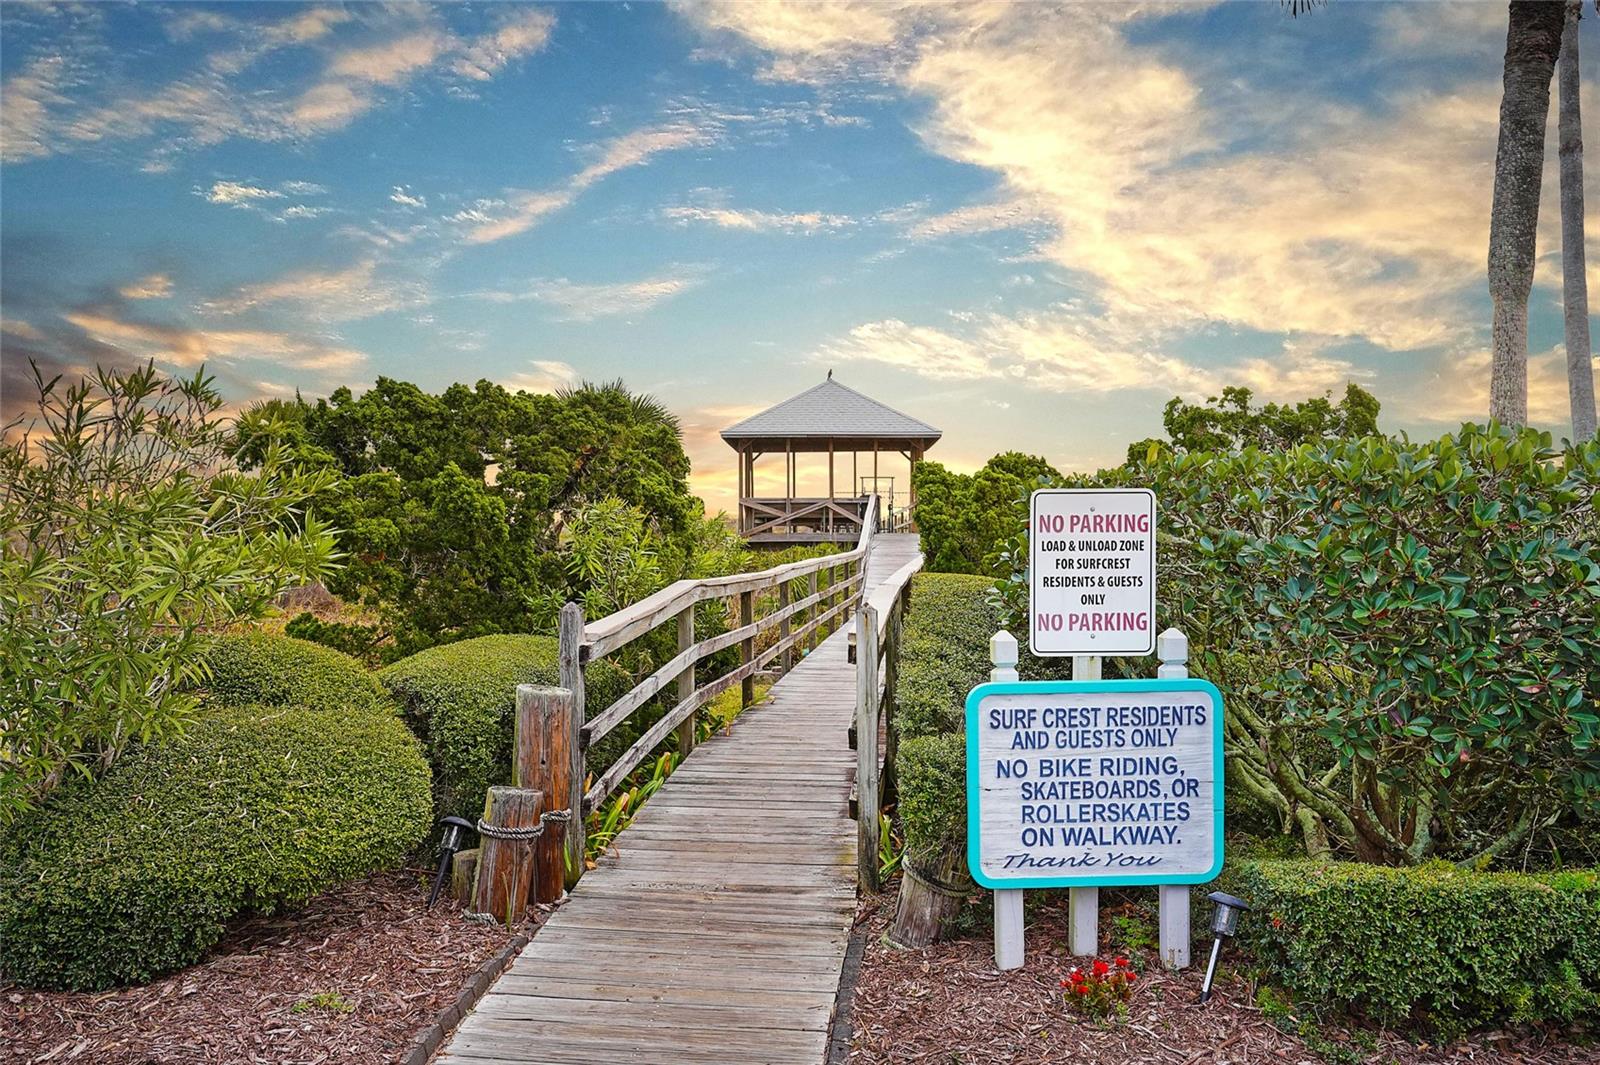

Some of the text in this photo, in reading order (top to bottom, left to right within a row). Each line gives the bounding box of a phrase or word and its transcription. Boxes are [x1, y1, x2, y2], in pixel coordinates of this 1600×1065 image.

[1040, 514, 1148, 533] NO PARKING
[1042, 540, 1144, 551] LOAD & UNLOAD ZONE
[1056, 559, 1130, 569] FOR SURFCREST
[1043, 576, 1143, 587] RESIDENTS & GUESTS
[1081, 594, 1105, 605] ONLY
[1038, 613, 1147, 631] NO PARKING
[990, 706, 1205, 729] SURF CREST RESIDENTS
[1012, 728, 1177, 750] AND GUESTS ONLY
[997, 757, 1185, 778] NO BIKE RIDING,
[1172, 779, 1199, 797] OR
[1022, 803, 1190, 823] ROLLERSKATES
[1022, 826, 1181, 846] ON WALKWAY.
[1003, 852, 1162, 869] Thank You
